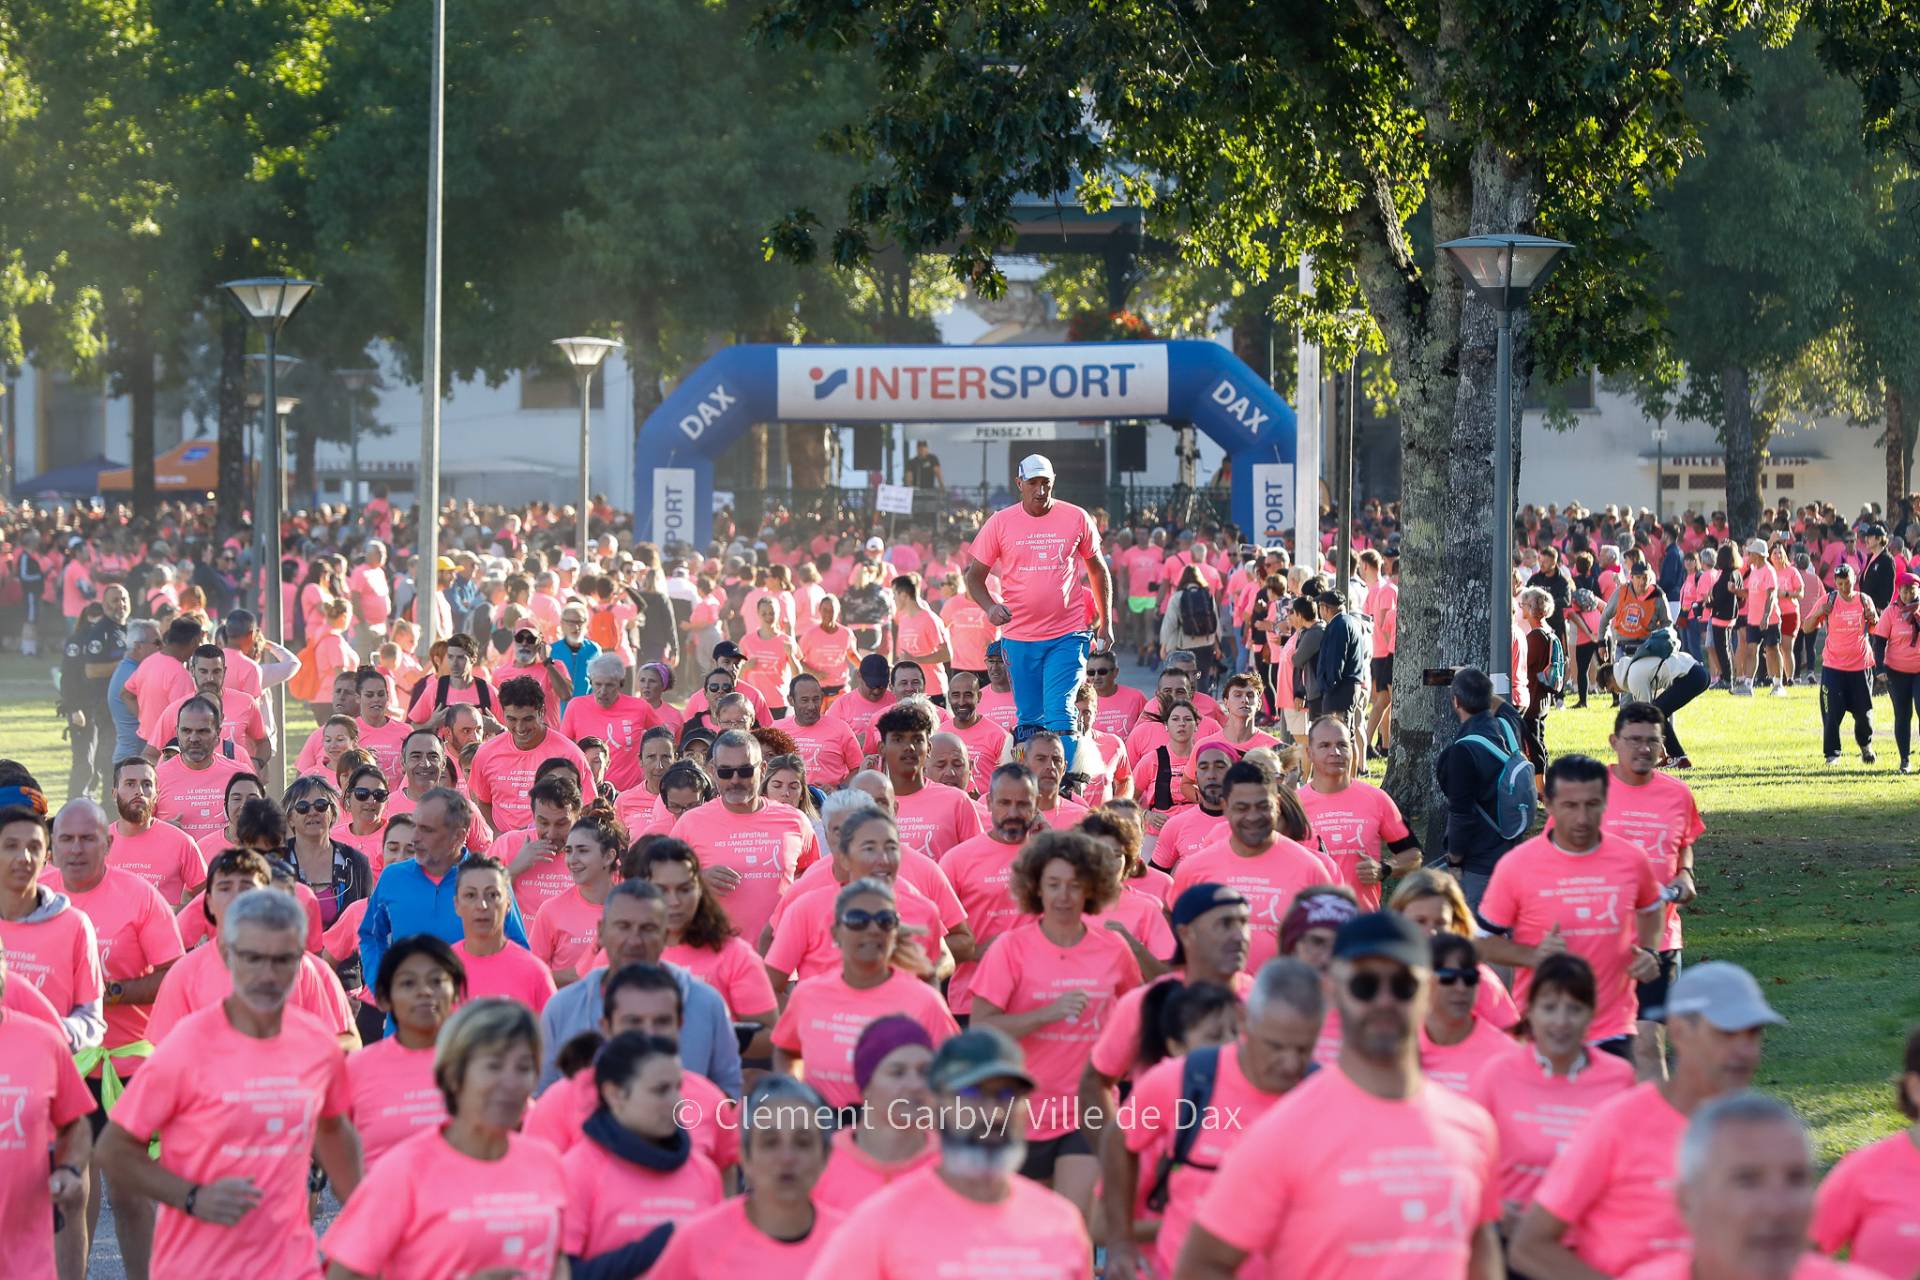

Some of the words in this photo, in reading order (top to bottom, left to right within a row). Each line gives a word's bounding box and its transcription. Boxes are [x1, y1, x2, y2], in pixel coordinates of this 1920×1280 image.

[855, 363, 1136, 401] INTERSPORT
[1211, 380, 1269, 434] DAX
[680, 384, 736, 440] DAX
